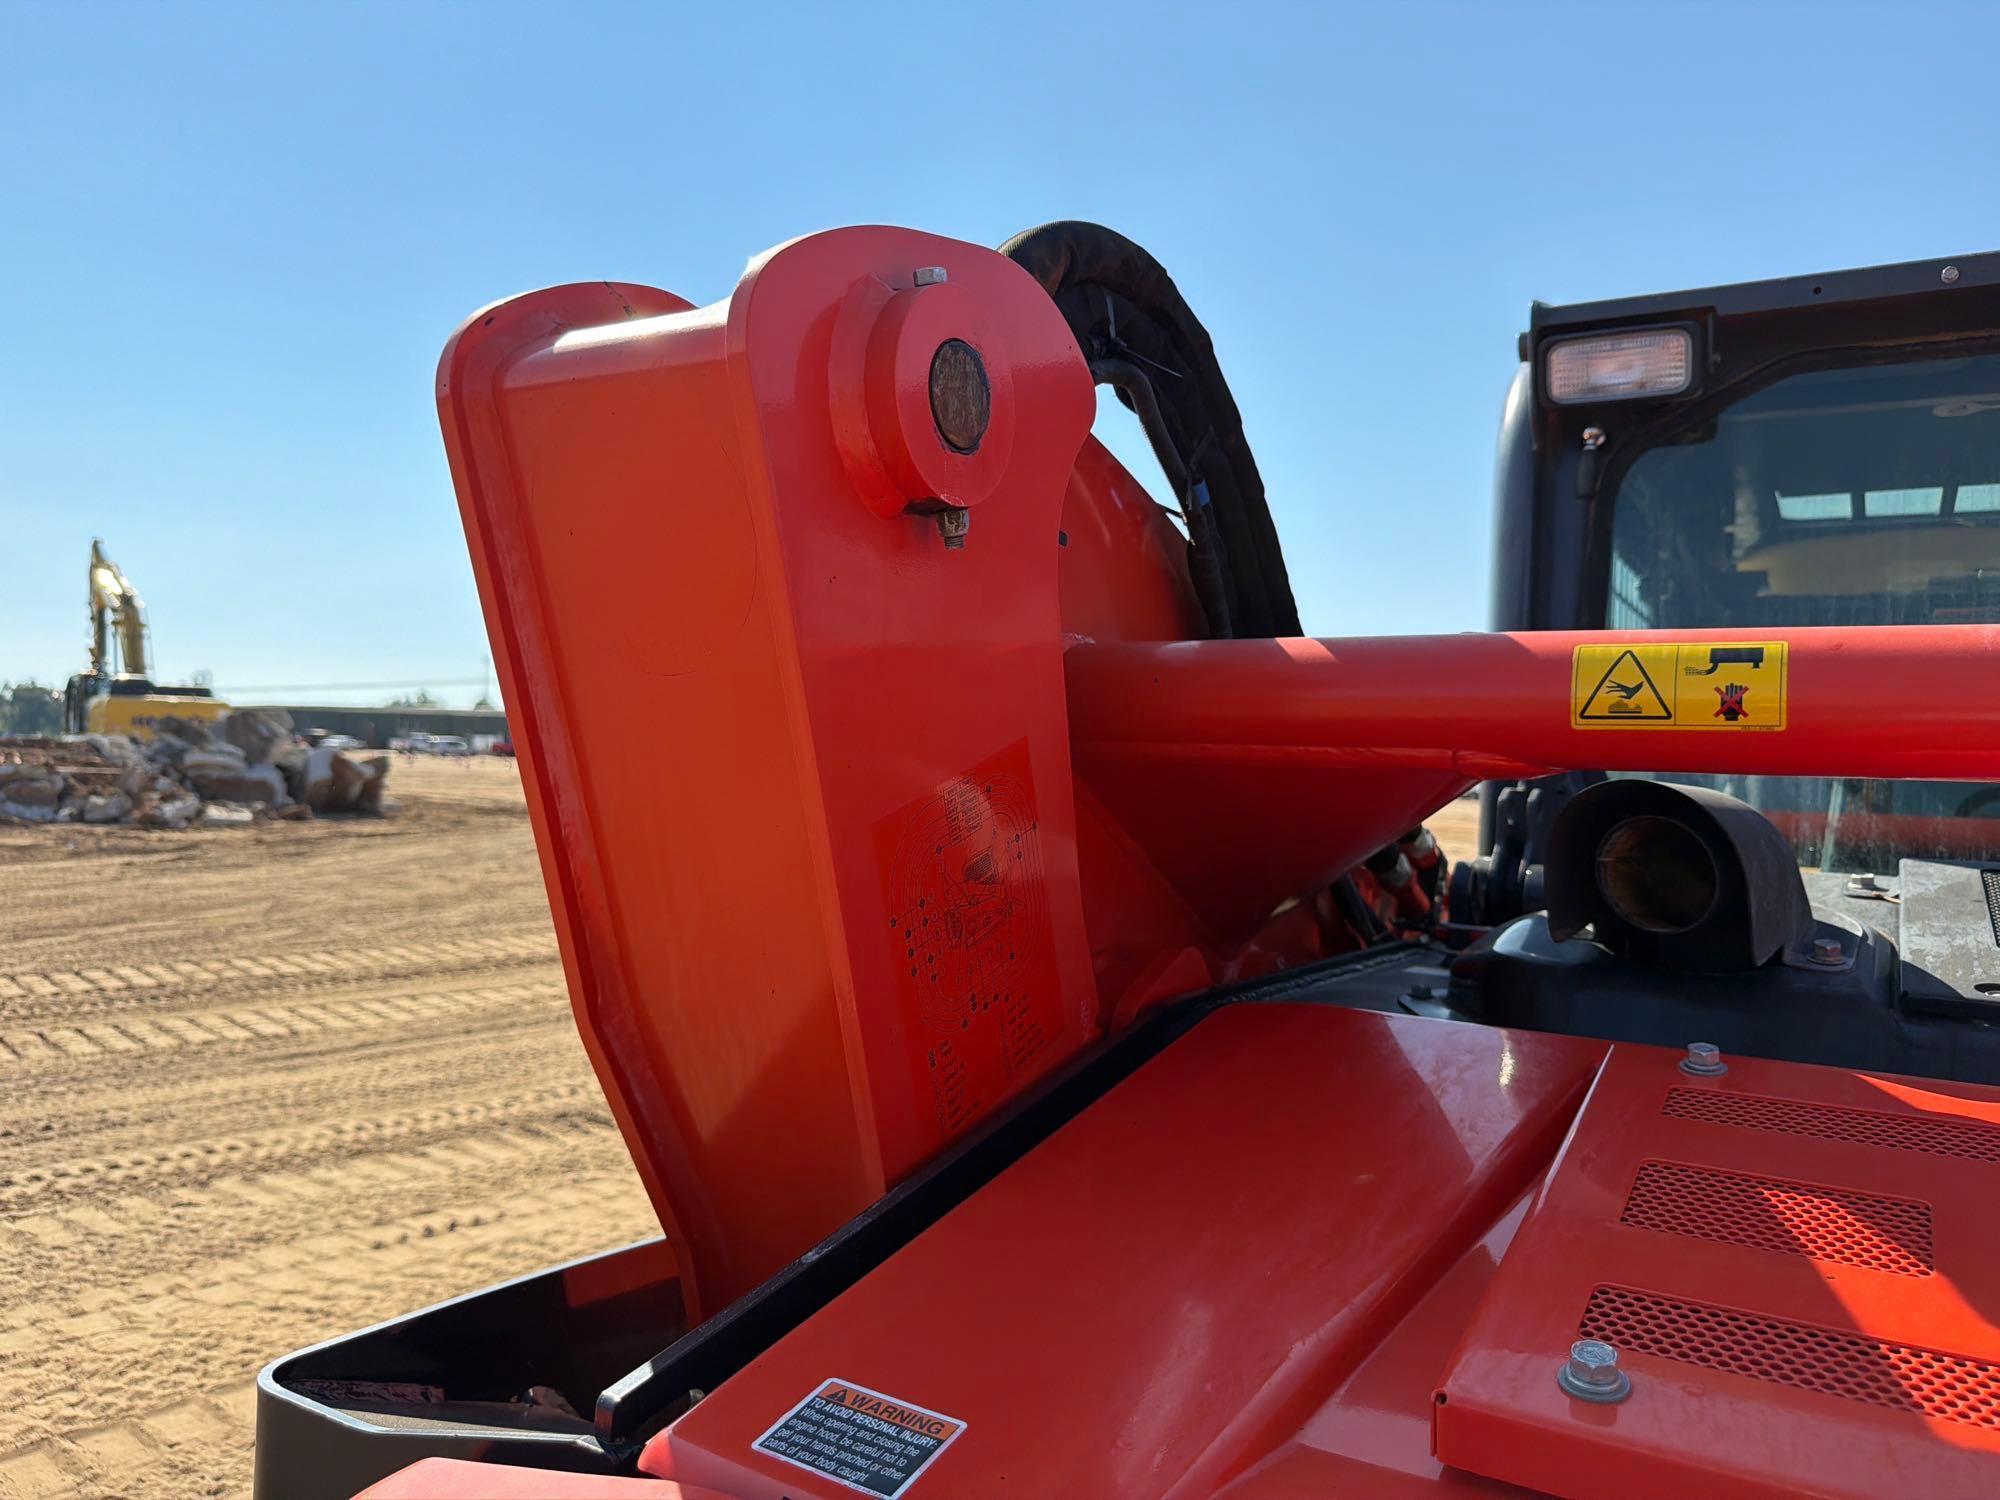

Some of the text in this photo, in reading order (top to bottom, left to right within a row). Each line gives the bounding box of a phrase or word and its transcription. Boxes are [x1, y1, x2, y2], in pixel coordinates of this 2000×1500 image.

[800, 1407, 920, 1457] When opening and closing the
[810, 1398, 938, 1449] TO AVOID PERSONAL INJURY:
[850, 1394, 945, 1435] WARNING
[763, 1438, 870, 1483] parts of your body caught
[774, 1427, 907, 1480] get your hands pinched or other
[788, 1419, 817, 1434] engine
[840, 1435, 853, 1447] be
[852, 1442, 883, 1459] careful
[881, 1451, 898, 1463] not
[896, 1456, 908, 1467] to
